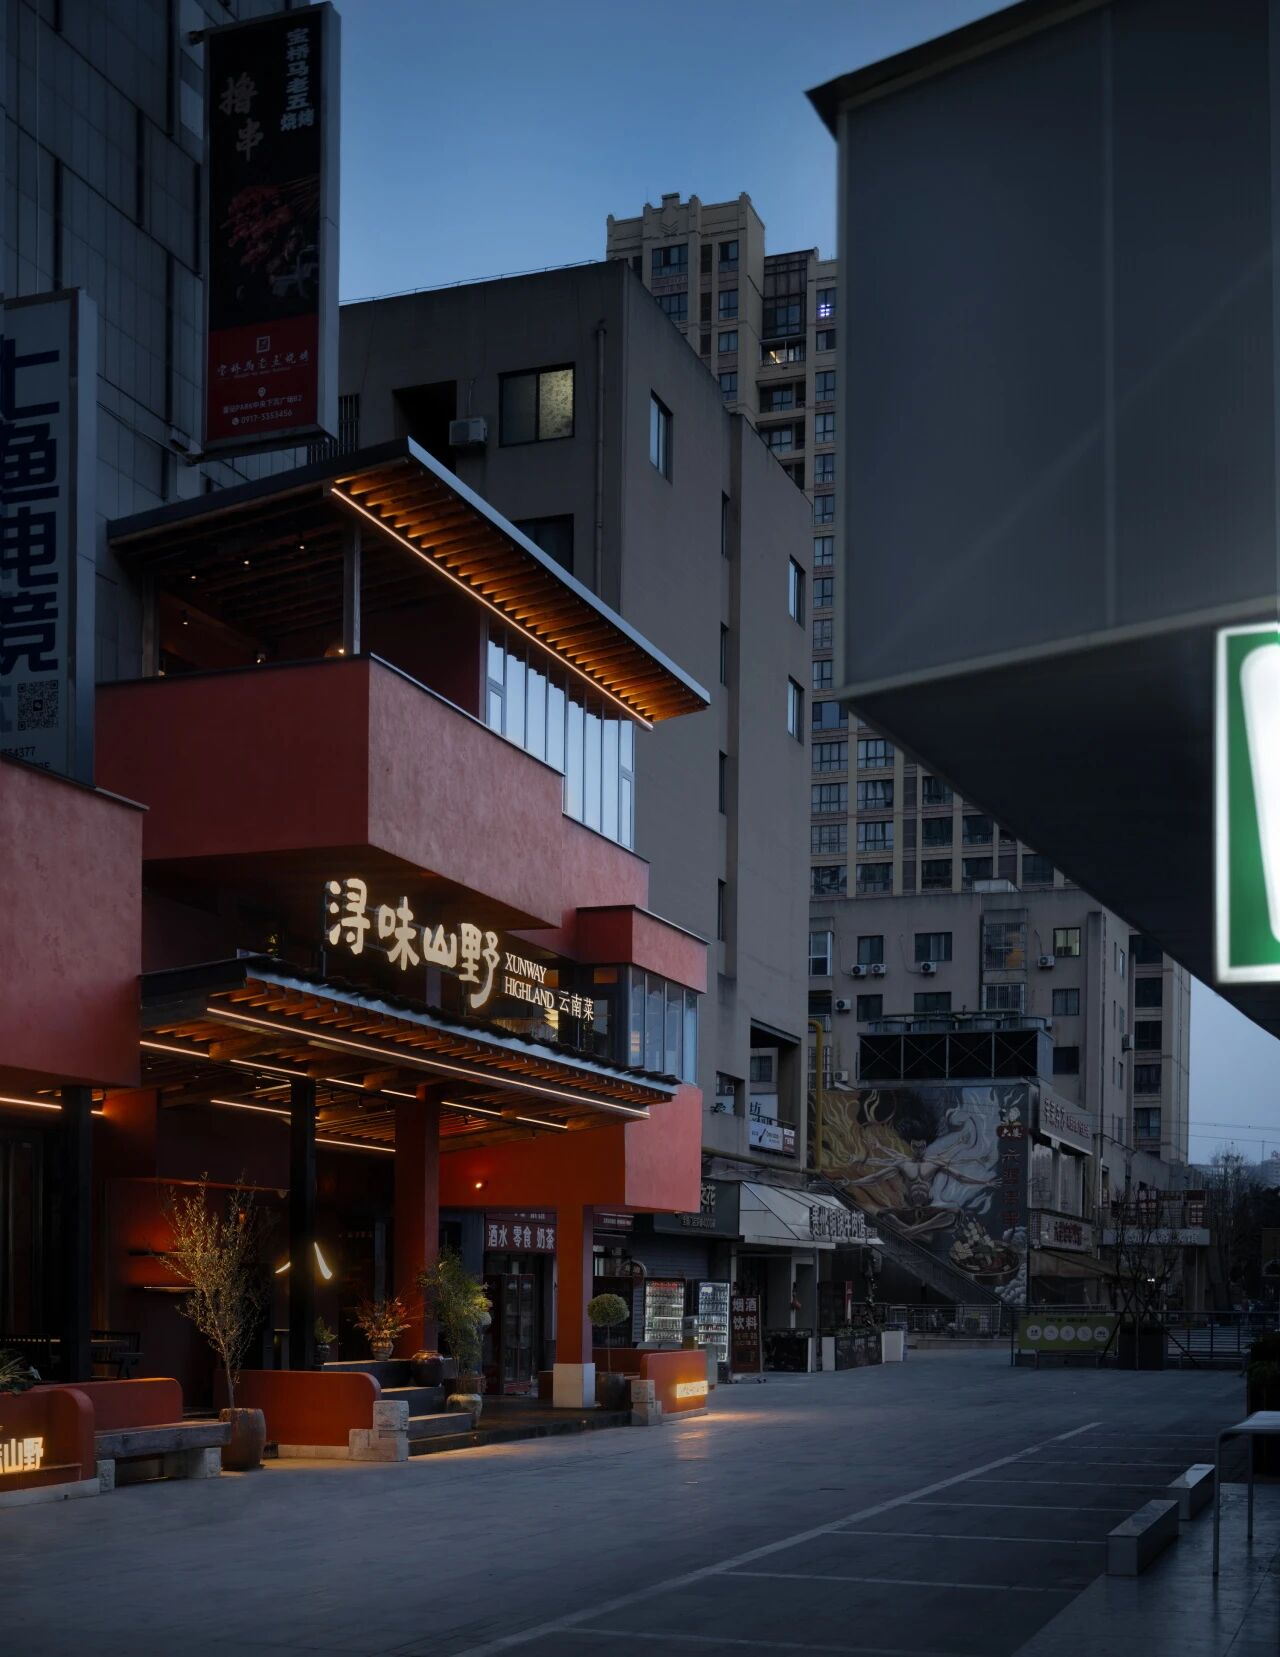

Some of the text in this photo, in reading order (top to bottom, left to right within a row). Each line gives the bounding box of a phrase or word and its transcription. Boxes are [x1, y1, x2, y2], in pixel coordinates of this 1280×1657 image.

[326, 878, 500, 1008] 浔味山野
[504, 952, 547, 985] XUNWAY
[504, 976, 555, 1010] HIGHLAND
[558, 990, 595, 1021] 云南菜
[488, 1224, 556, 1250] 酒水 零食 奶茶
[732, 1297, 757, 1312] 烟酒
[733, 1315, 757, 1331] 饮料
